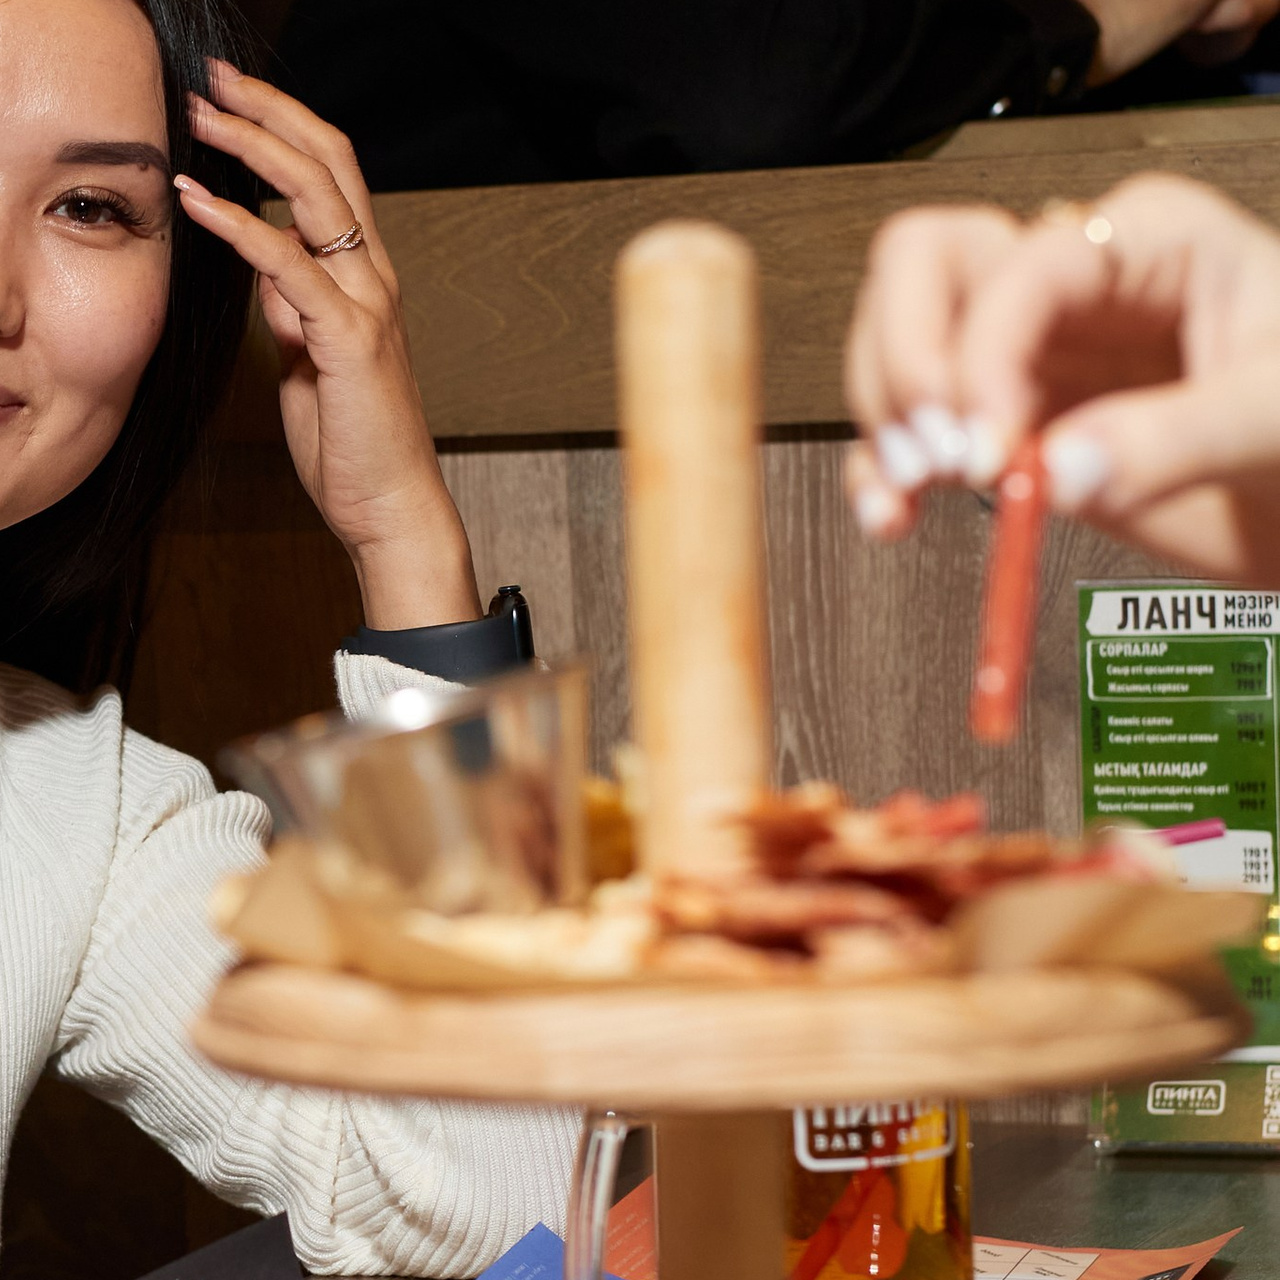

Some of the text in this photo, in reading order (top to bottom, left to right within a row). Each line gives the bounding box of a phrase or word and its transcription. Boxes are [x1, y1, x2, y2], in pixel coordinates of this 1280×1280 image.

[1117, 595, 1279, 630] ЛАНЧ МӘЗІРІ
[1224, 613, 1272, 628] МЕНЮ
[1099, 642, 1168, 658] СОРПАЛАР
[1154, 1086, 1217, 1101] ПИНТА
